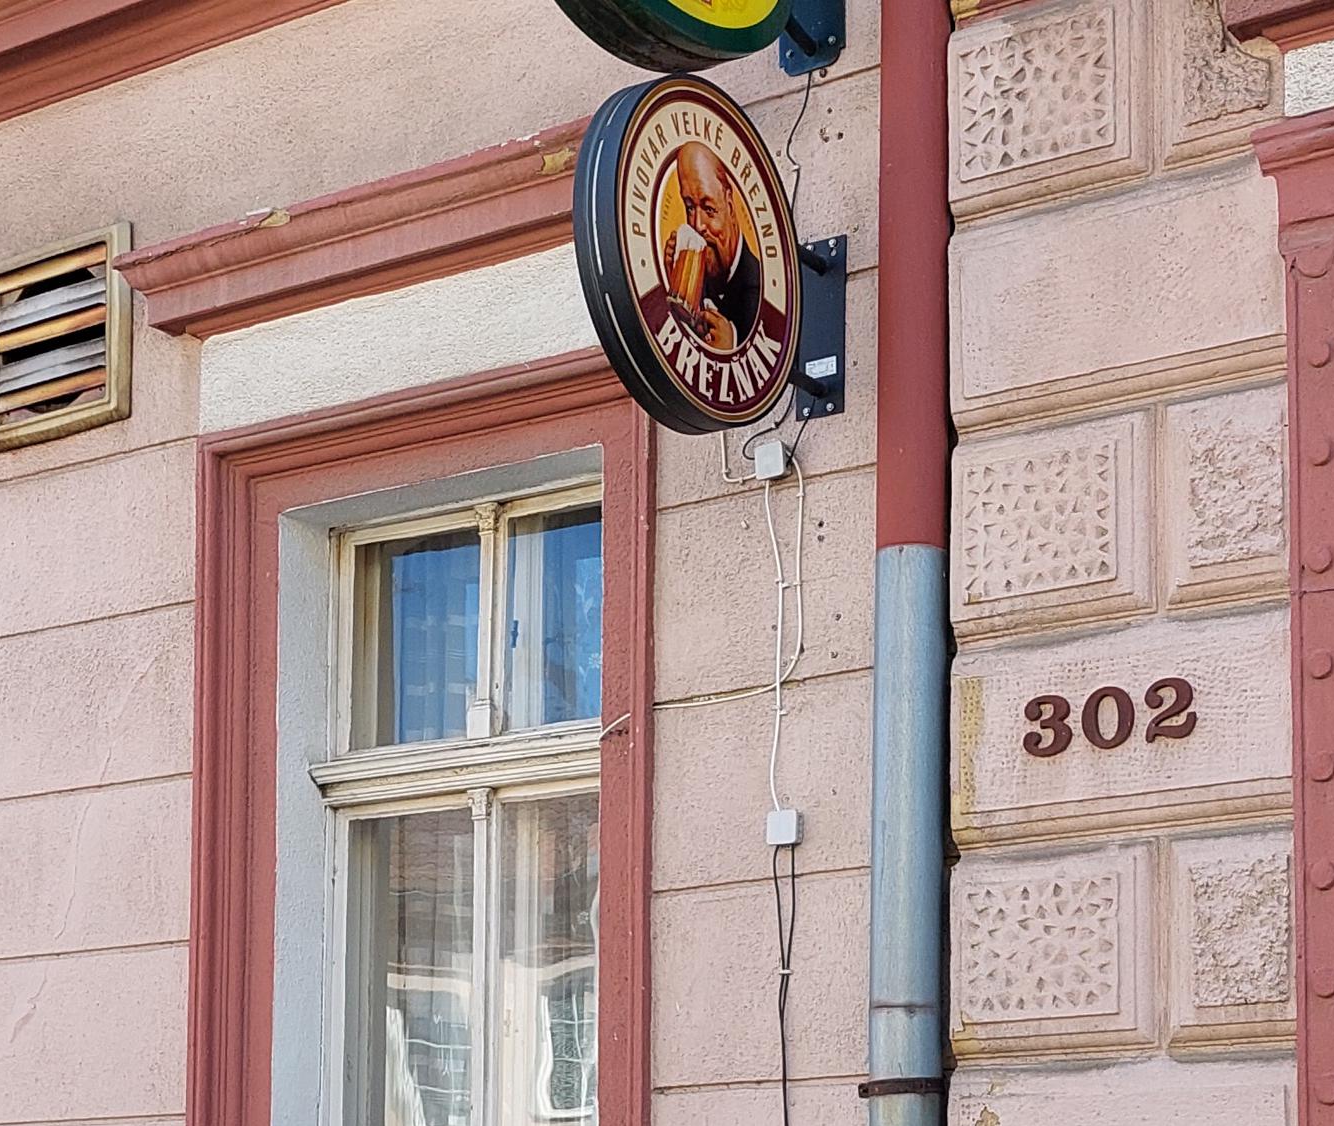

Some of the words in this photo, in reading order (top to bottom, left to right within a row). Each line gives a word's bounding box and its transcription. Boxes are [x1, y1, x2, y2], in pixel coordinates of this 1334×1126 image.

[632, 123, 666, 238] PIVOVAR
[671, 111, 723, 150] VELKÉ
[731, 146, 778, 259] BŘEZNO
[655, 312, 782, 405] BŘEZŇÁK
[1023, 677, 1197, 758] 302
